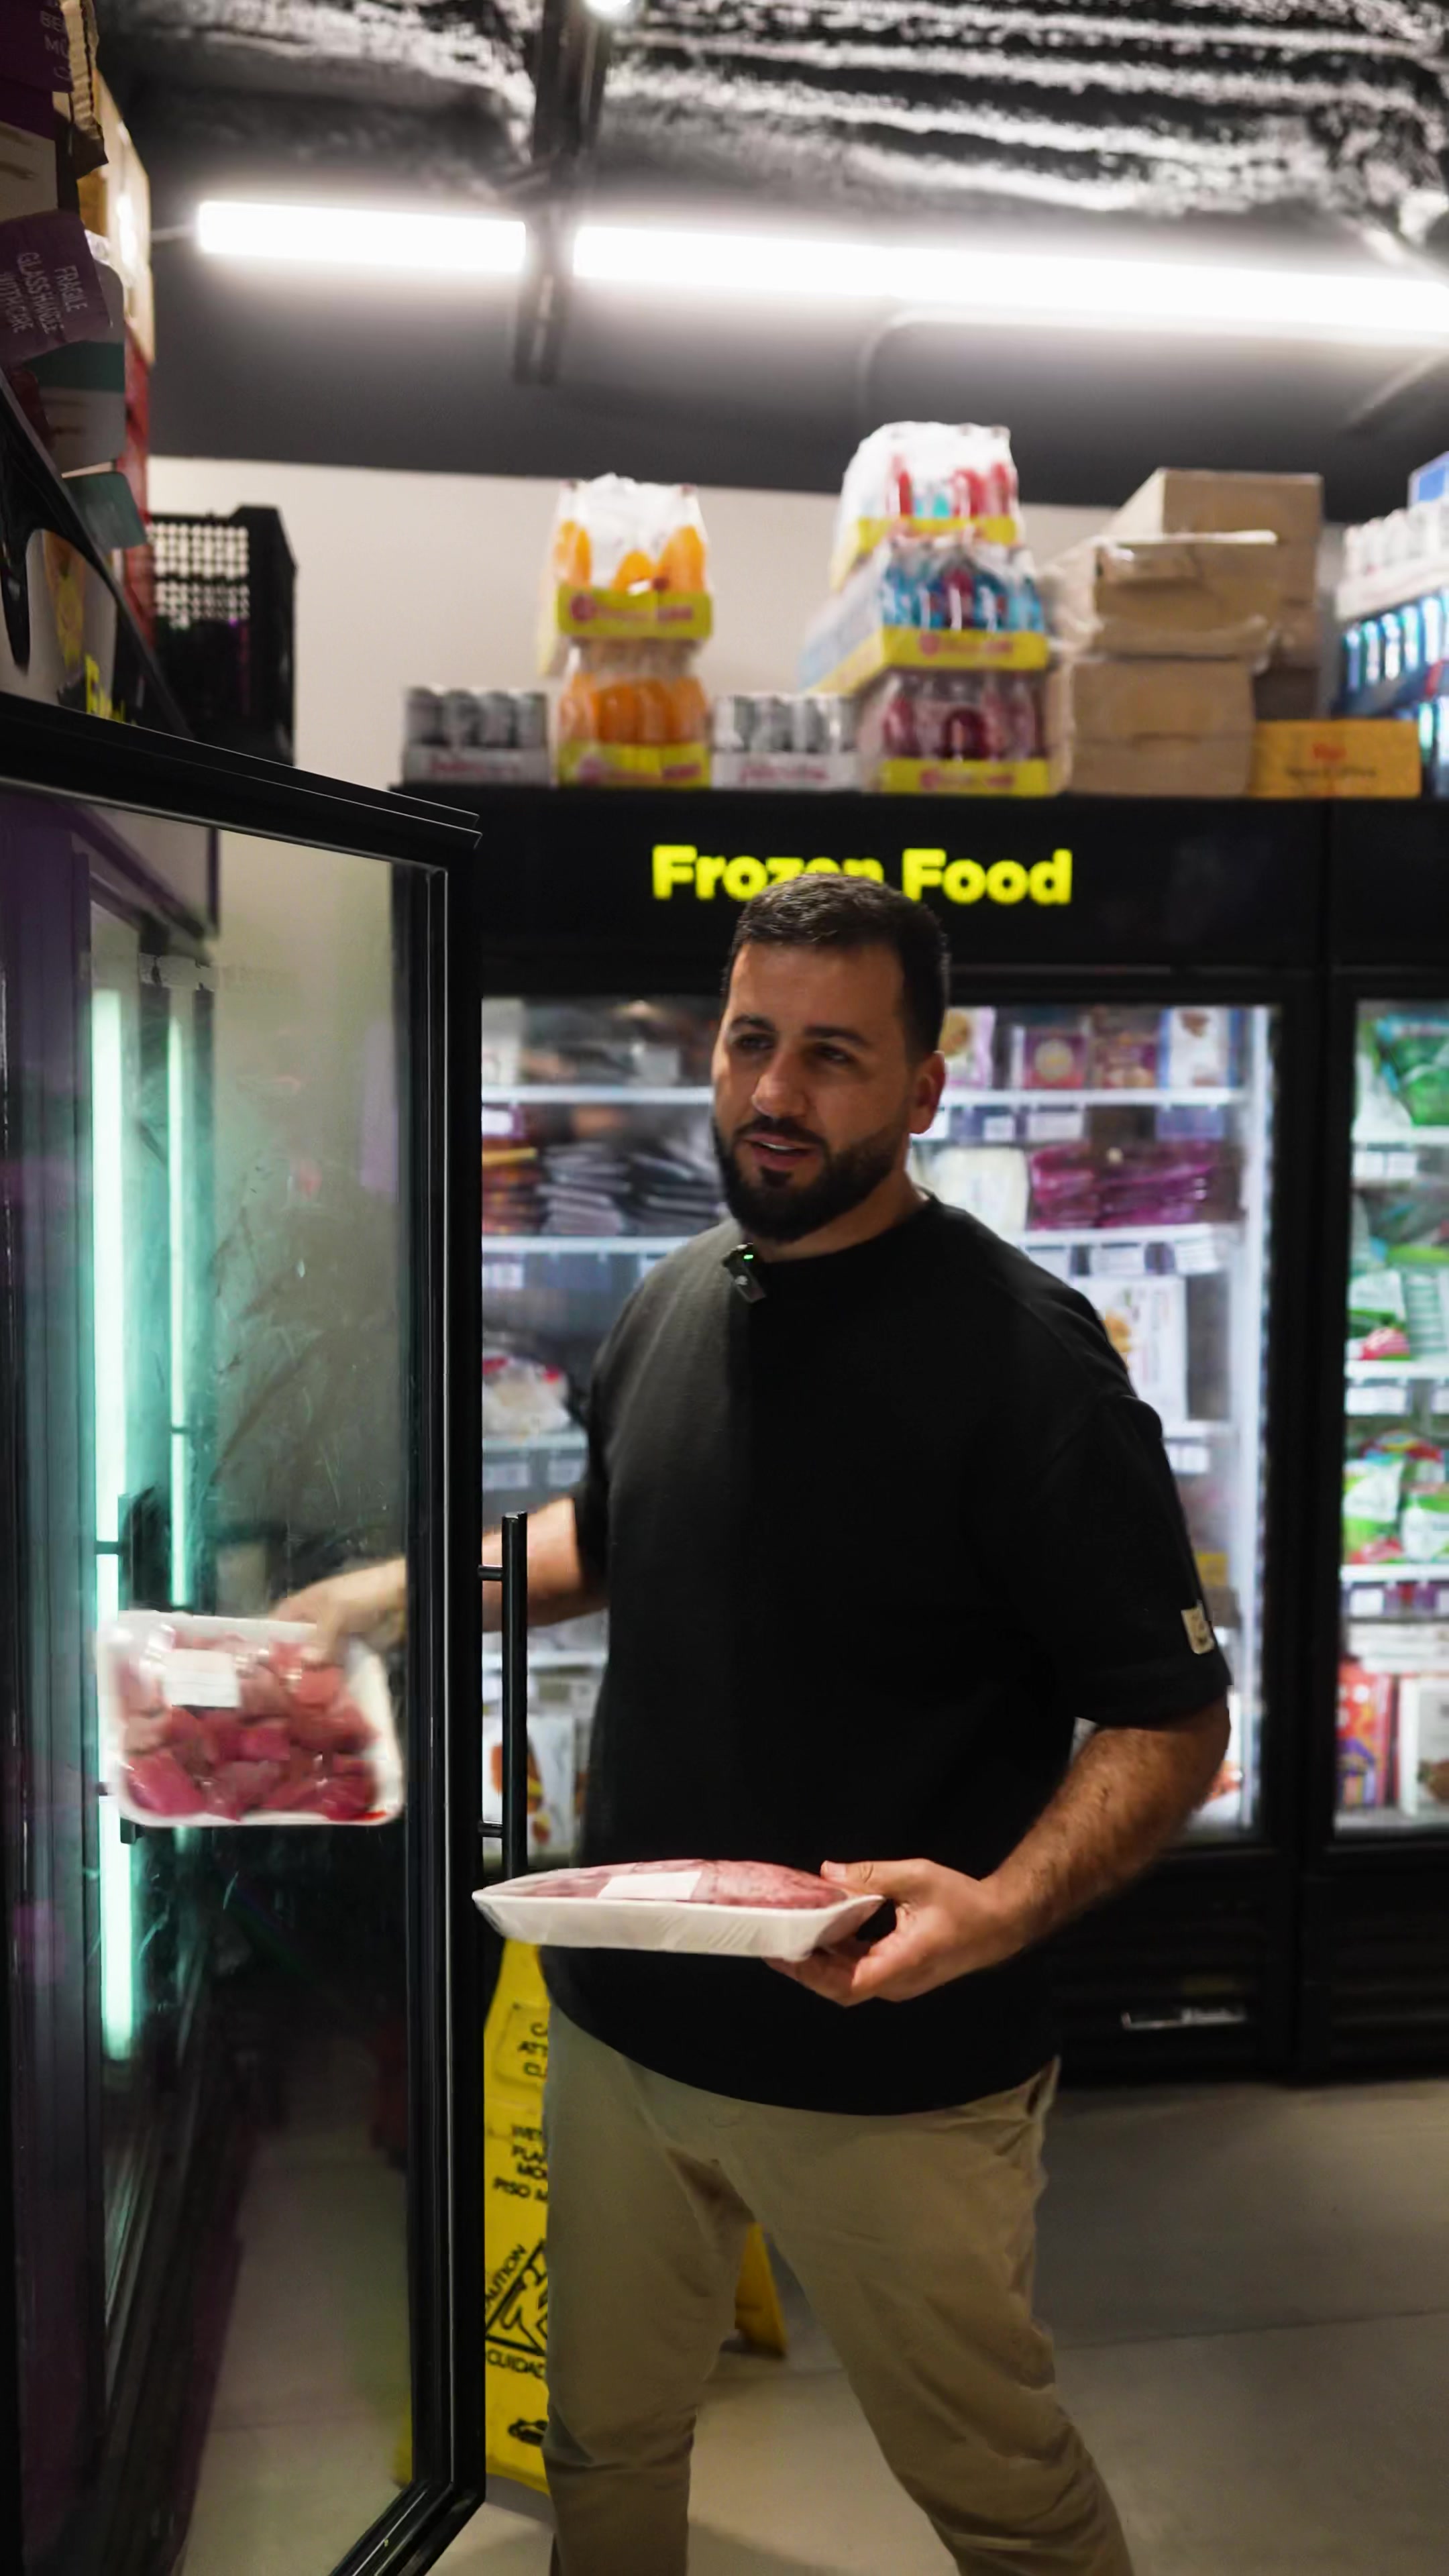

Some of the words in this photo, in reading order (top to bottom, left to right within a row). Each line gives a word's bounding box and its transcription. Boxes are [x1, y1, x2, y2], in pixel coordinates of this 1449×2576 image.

[17, 252, 51, 294] GLASS
[54, 264, 88, 313] FRAGILE
[33, 291, 64, 334] HANDLE
[902, 848, 1073, 904] Food
[493, 2176, 531, 2198] PISO
[485, 2243, 526, 2308] AUTION
